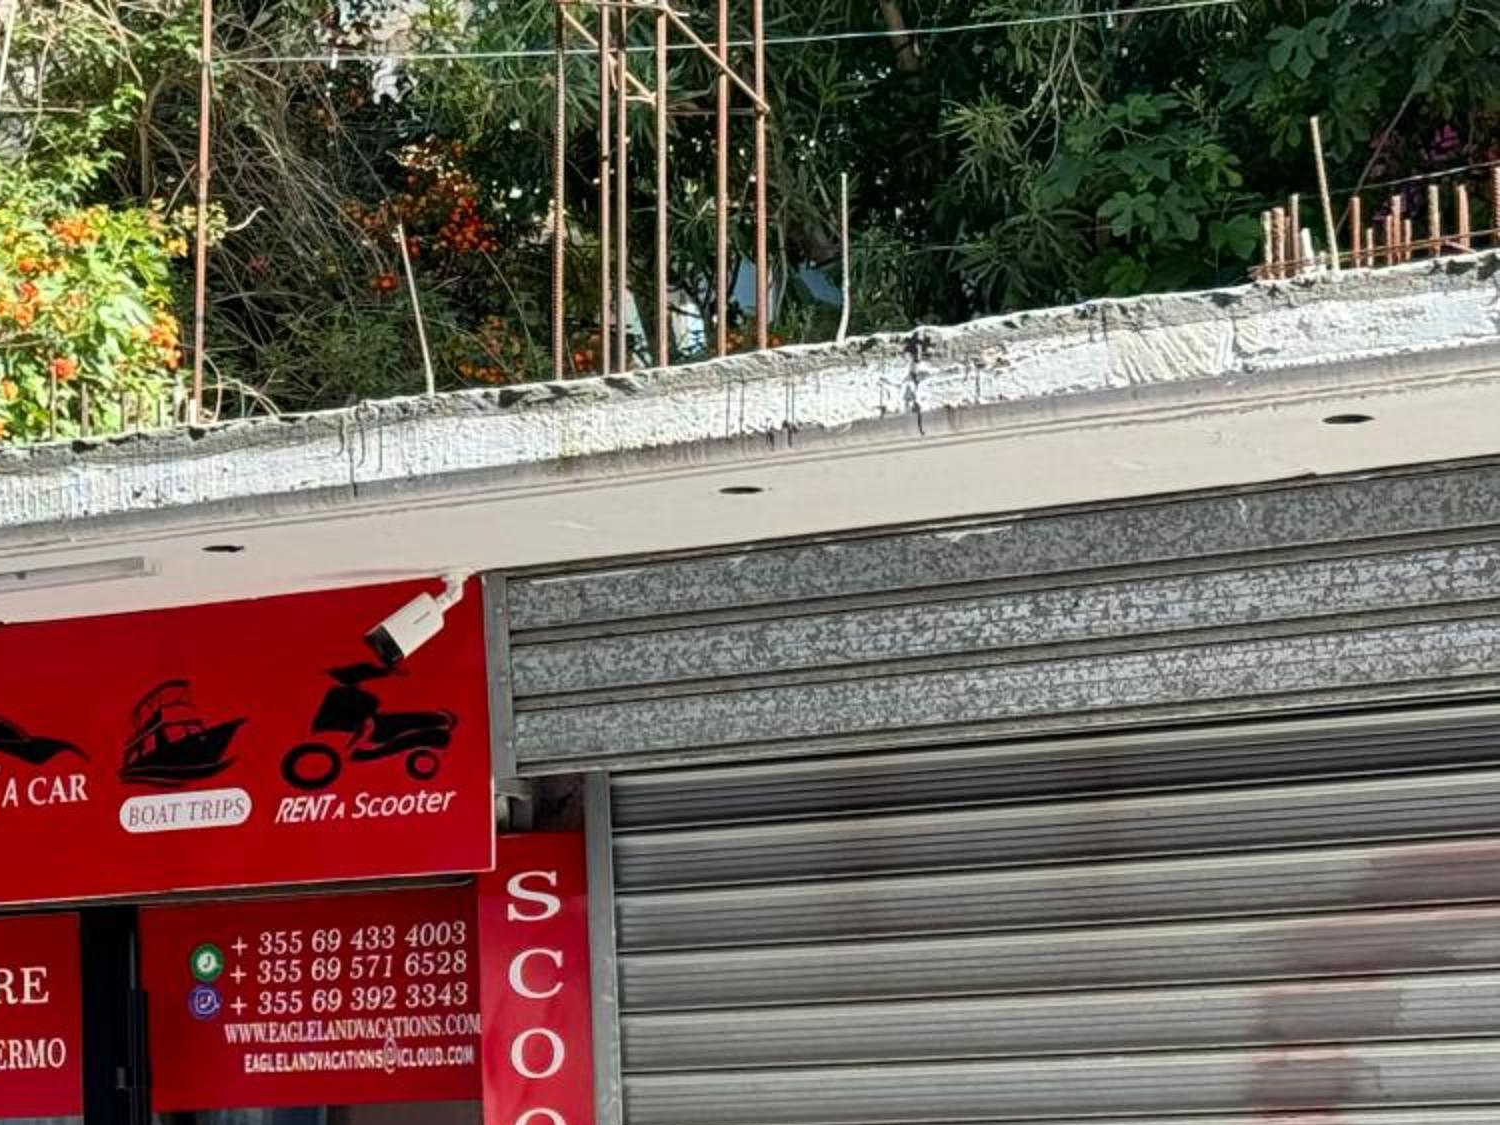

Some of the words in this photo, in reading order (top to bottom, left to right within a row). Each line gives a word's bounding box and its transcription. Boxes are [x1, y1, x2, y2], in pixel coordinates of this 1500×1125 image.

[2, 784, 19, 809] A
[27, 774, 88, 806] CAR
[275, 795, 334, 824] RENT
[332, 806, 345, 820] A
[352, 788, 457, 819] Scooter
[127, 802, 183, 828] BOAT
[186, 796, 246, 822] TRIPS
[258, 931, 303, 955] 355
[311, 928, 342, 952] 69
[350, 925, 396, 951] 433
[404, 920, 466, 947] 4003
[257, 960, 302, 984] 355
[311, 957, 342, 981] 69
[350, 954, 393, 979] 571
[405, 951, 467, 976] 6528
[257, 990, 303, 1015] 355
[311, 988, 342, 1012] 69
[351, 985, 397, 1010] 392
[405, 982, 468, 1008] 3343
[224, 1013, 481, 1044] WWW.EAGLELANDVACATIONS.COM
